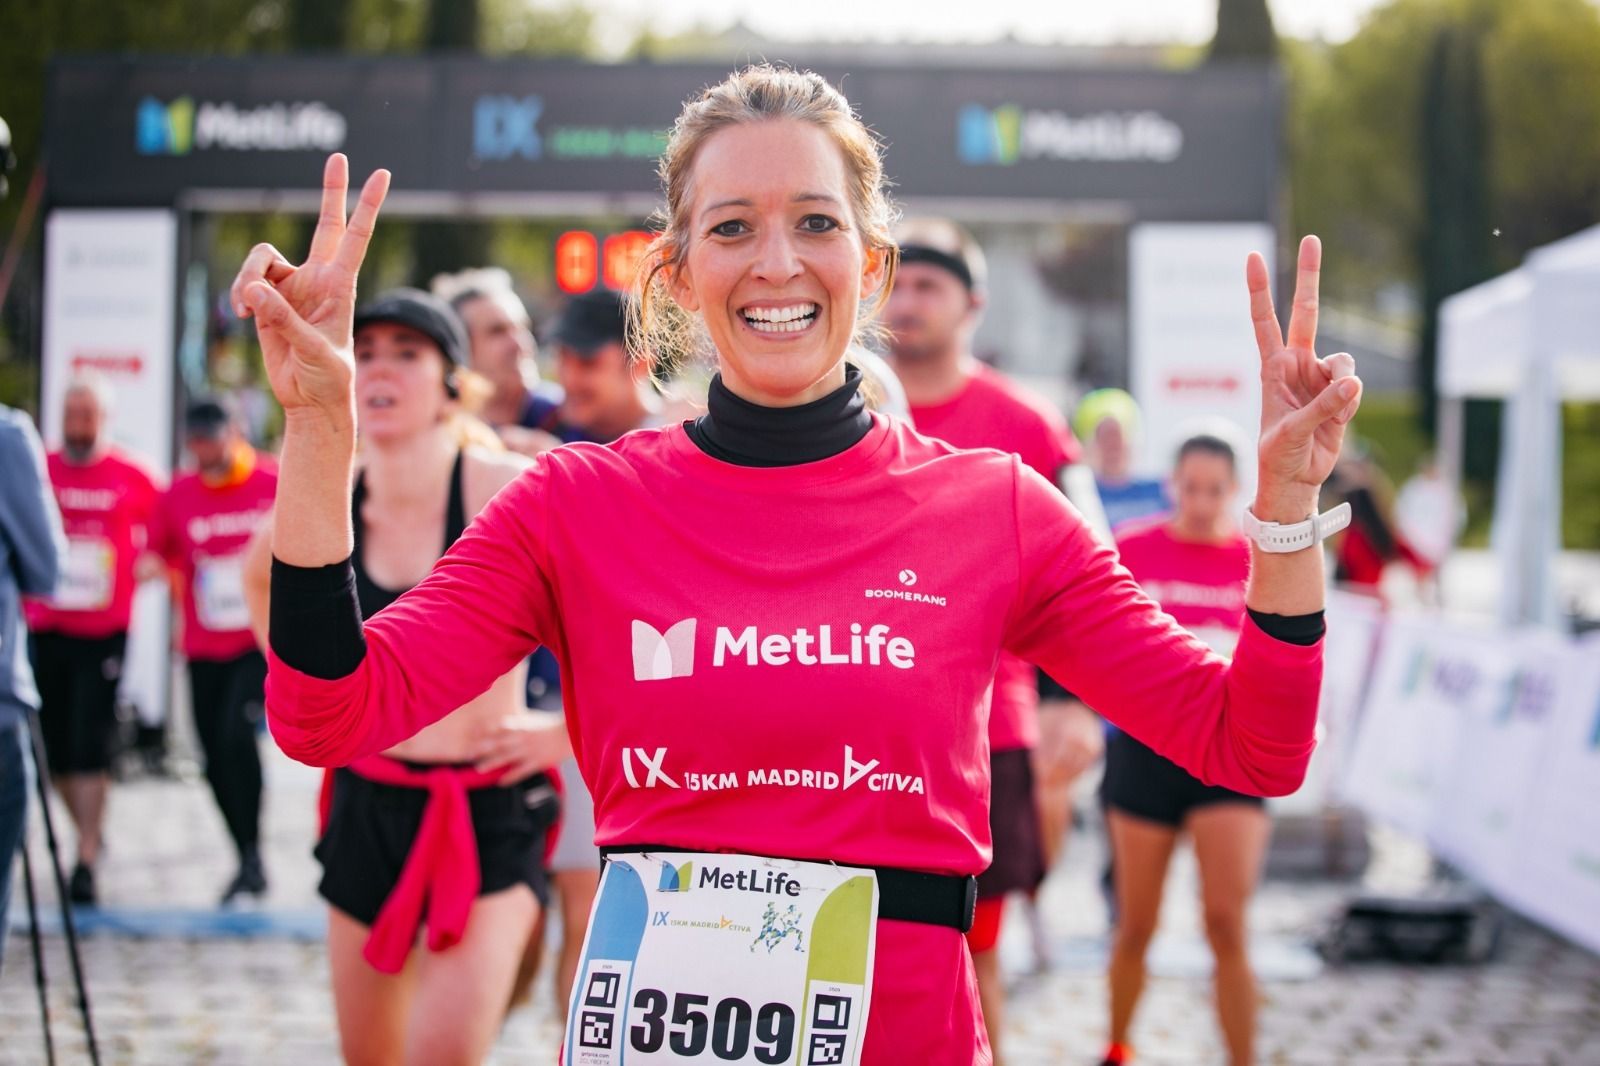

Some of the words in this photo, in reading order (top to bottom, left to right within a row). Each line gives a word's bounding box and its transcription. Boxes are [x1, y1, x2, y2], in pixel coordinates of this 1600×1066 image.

[197, 101, 346, 152] MetLife
[1024, 108, 1183, 163] MetLife
[865, 588, 947, 607] BOOMERANG
[712, 622, 915, 670] MetLife
[621, 747, 681, 789] IX
[684, 771, 739, 791] 15KM
[699, 866, 801, 897] MetLife
[652, 911, 670, 926] IX
[630, 988, 796, 1065] 3509
